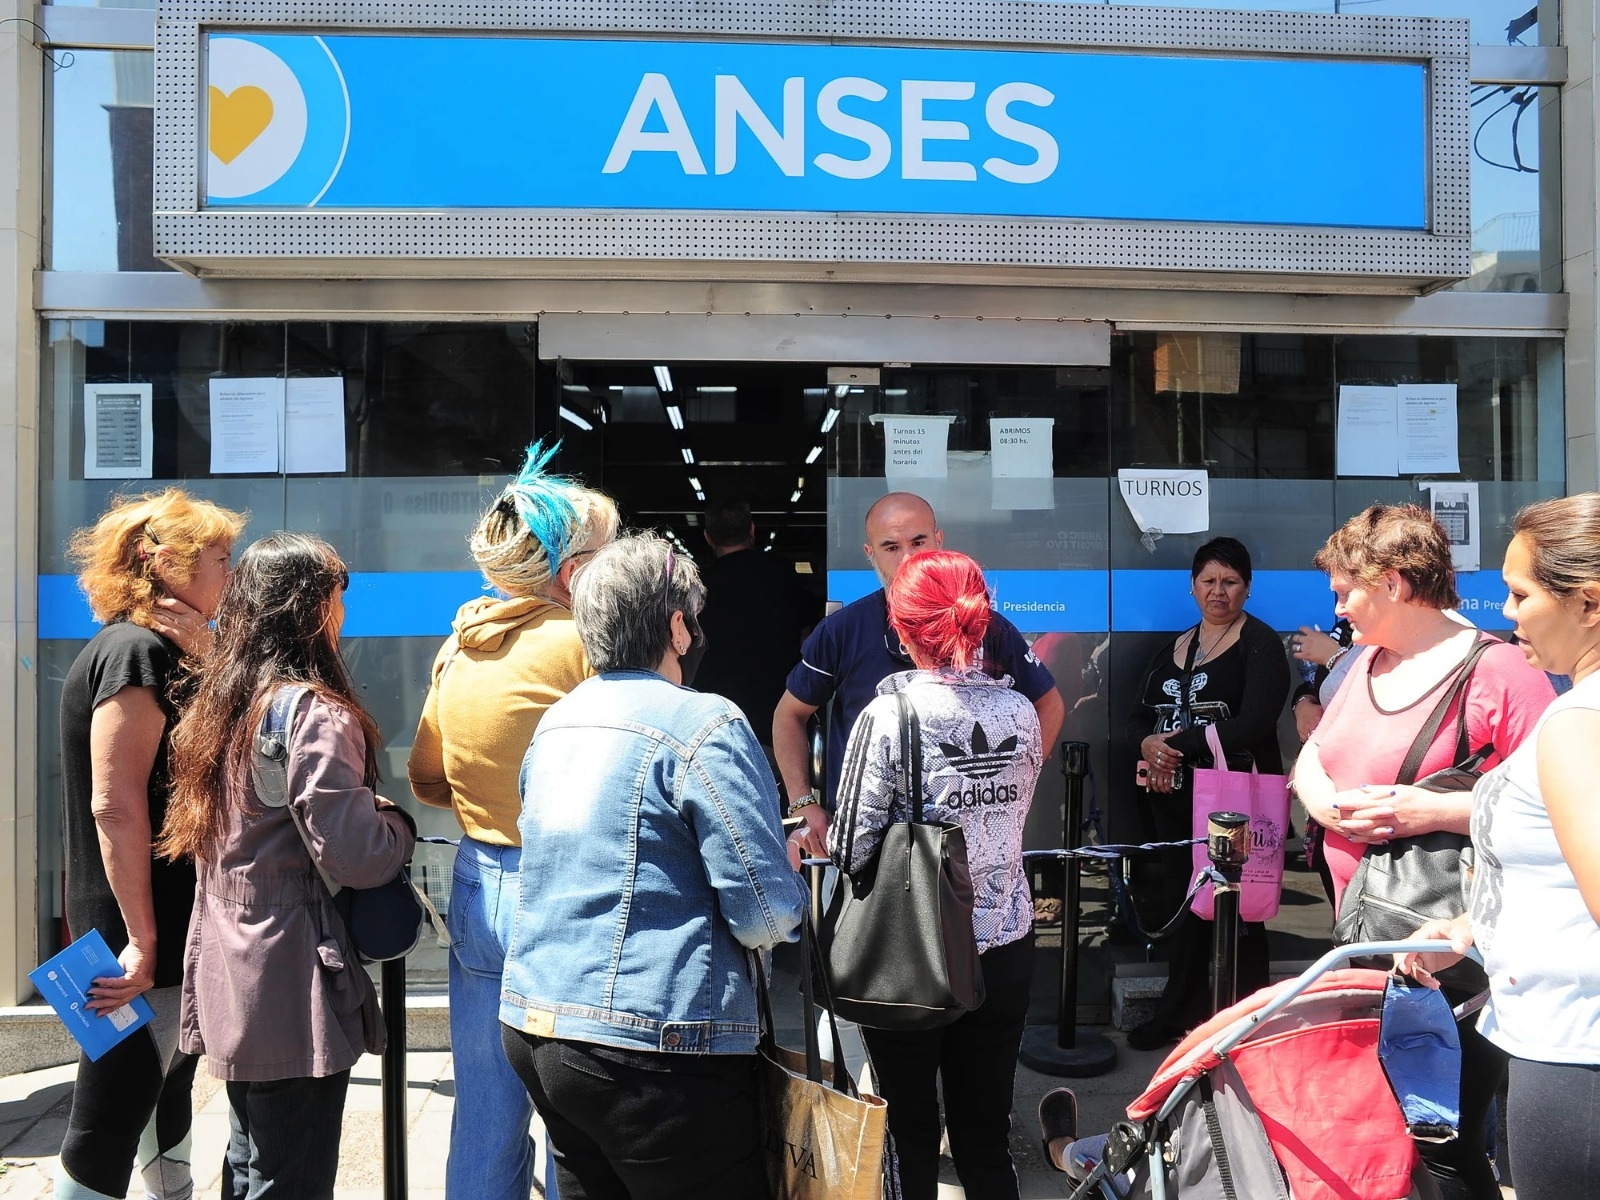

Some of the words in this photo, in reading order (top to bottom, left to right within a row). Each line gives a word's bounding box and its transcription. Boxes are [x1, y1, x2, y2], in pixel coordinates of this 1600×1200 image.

[601, 72, 1060, 184] ANSES
[1123, 480, 1202, 496] TURNOS
[1003, 601, 1066, 612] Presidencia
[947, 781, 1018, 809] adidas
